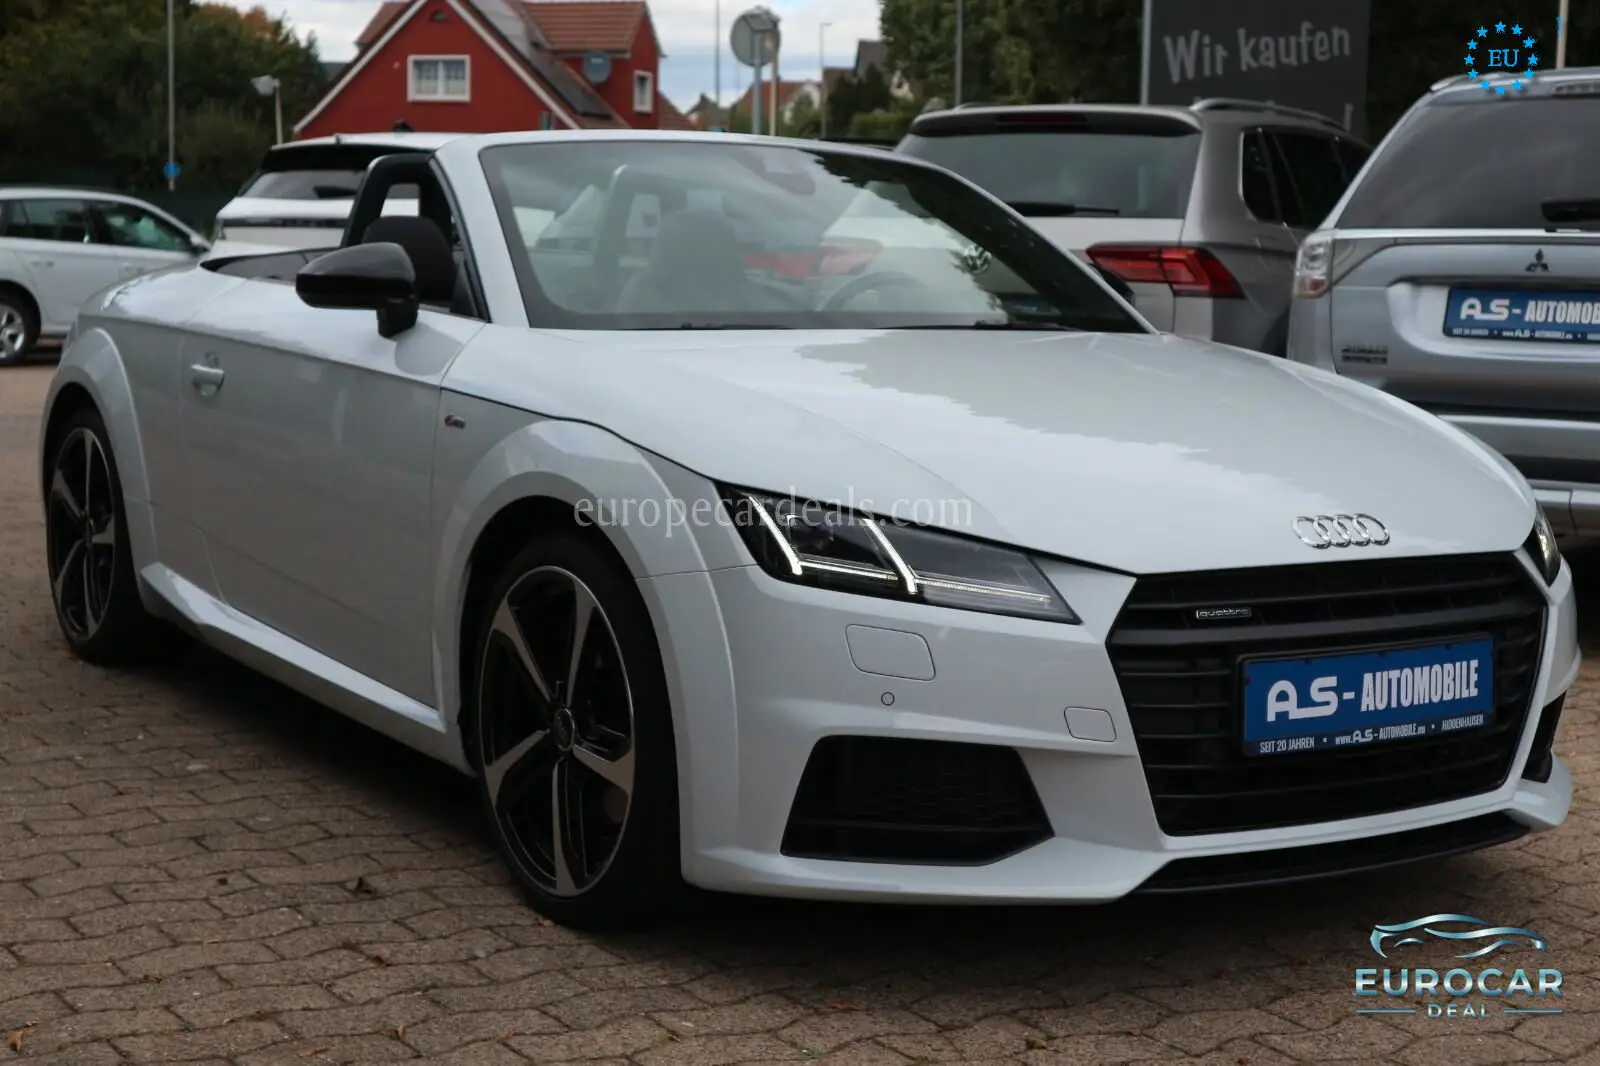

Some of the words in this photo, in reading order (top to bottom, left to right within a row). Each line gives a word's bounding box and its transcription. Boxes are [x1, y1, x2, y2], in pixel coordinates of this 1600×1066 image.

[1163, 30, 1228, 84] Wir
[1237, 21, 1350, 72] kaufen
[1260, 740, 1275, 753] SEIT
[1276, 740, 1287, 752] 20
[1288, 736, 1315, 751] JAHREN
[1442, 713, 1484, 731] HIDDENHAUSEN
